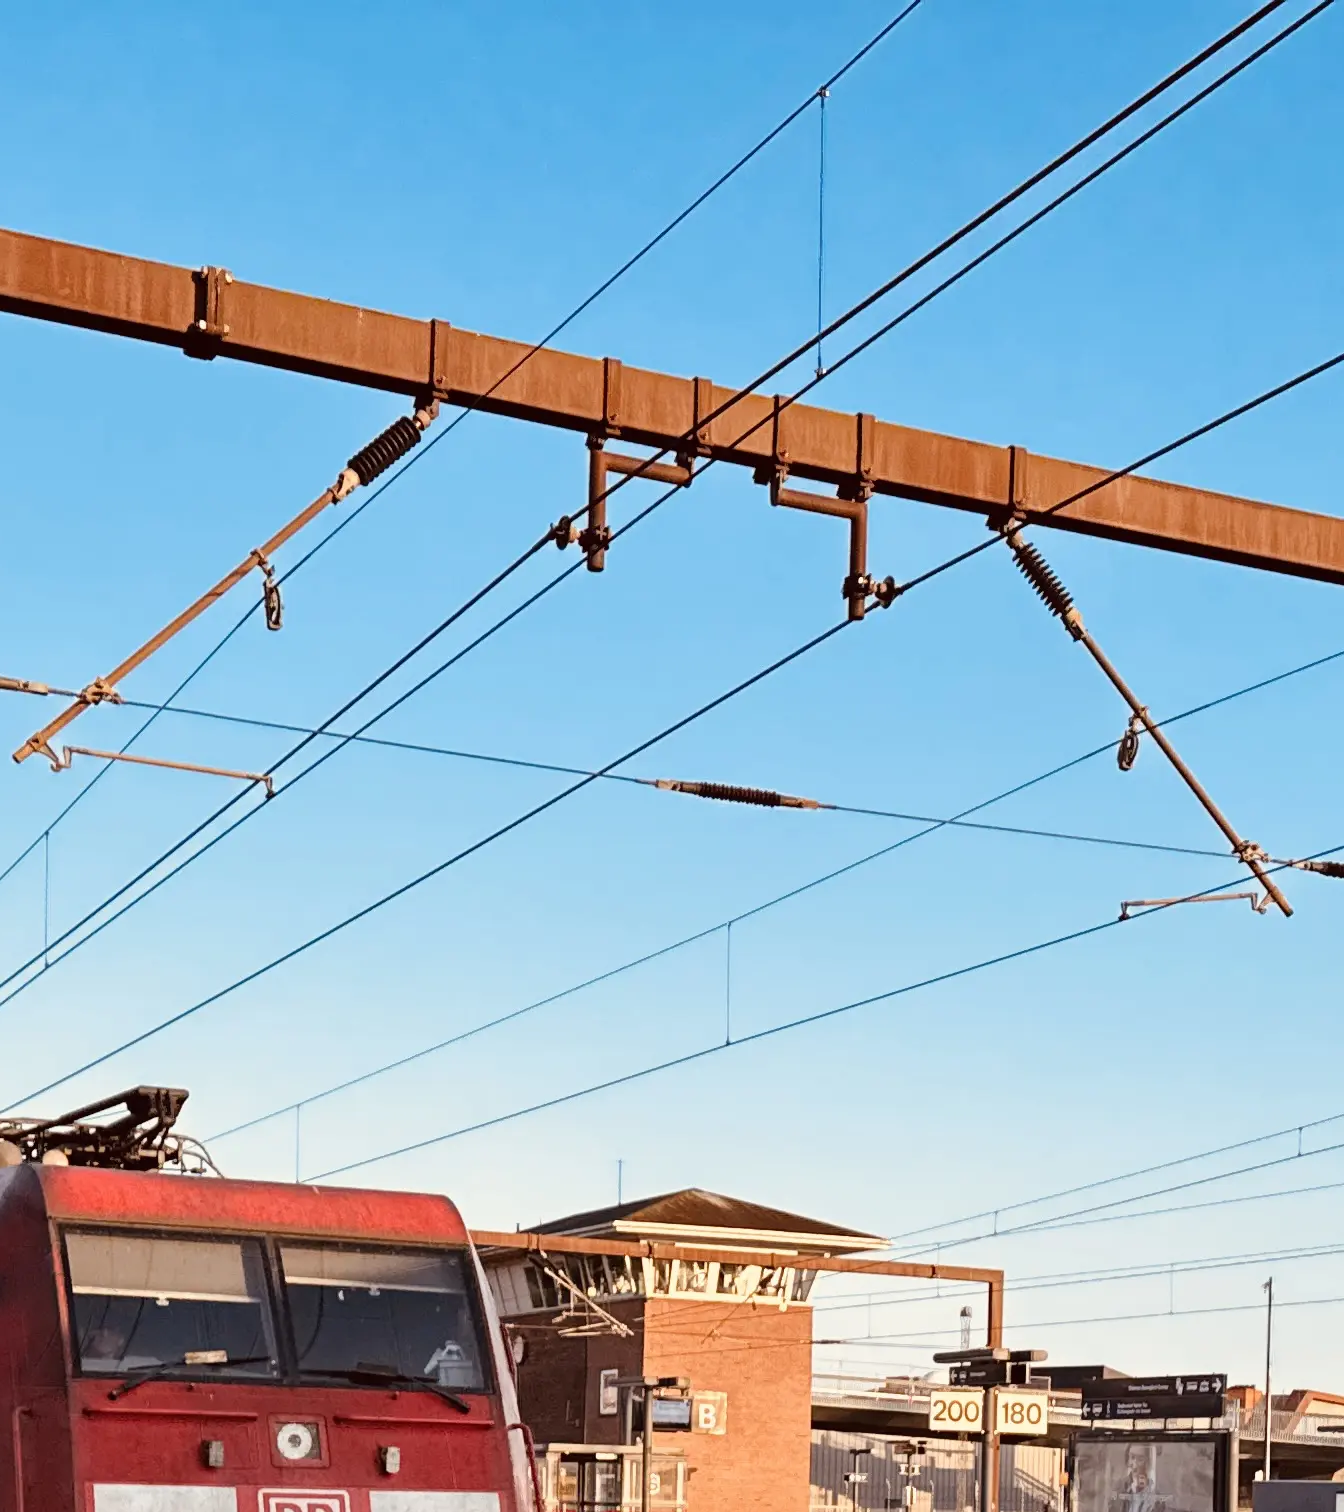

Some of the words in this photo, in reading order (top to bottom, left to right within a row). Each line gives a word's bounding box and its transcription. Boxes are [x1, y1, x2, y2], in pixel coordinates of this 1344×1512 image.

[699, 1404, 716, 1429] B
[933, 1400, 979, 1422] 200
[1002, 1402, 1041, 1424] 180
